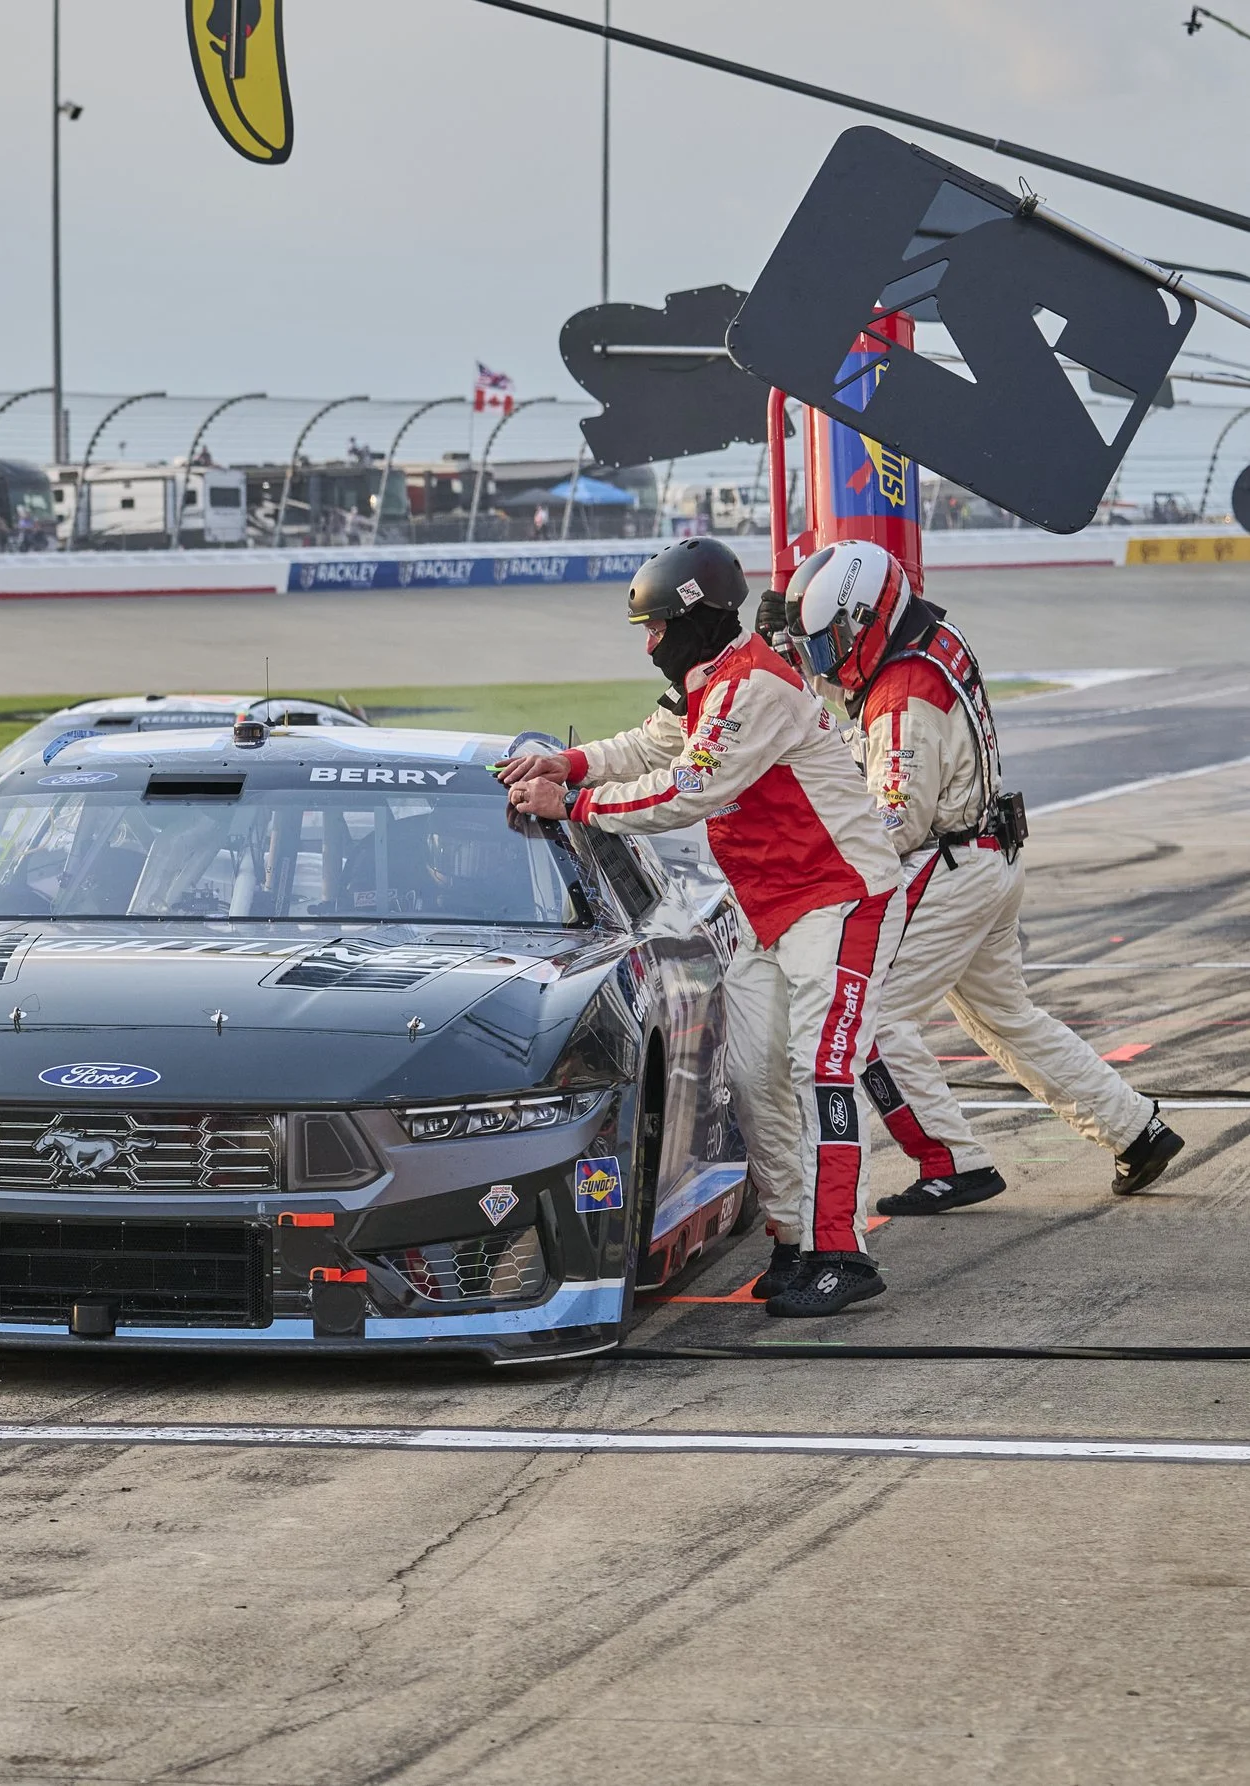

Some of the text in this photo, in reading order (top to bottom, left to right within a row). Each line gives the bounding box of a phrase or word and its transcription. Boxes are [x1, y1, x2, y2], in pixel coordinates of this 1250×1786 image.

[316, 562, 379, 582] RACKLEY
[414, 559, 475, 579] RACKLEY
[510, 558, 569, 576] RACKLEY
[840, 561, 859, 602] FREIGHTLINER
[711, 717, 740, 732] NASCAR
[700, 738, 726, 752] SIMPSON
[688, 751, 719, 767] SUNOCO
[52, 772, 104, 785] Ford
[309, 767, 457, 786] BERRY
[825, 981, 861, 1076] Motorcraft
[61, 1065, 138, 1085] Ford
[580, 1177, 615, 1195] SUNOCO
[489, 1195, 511, 1214] 75
